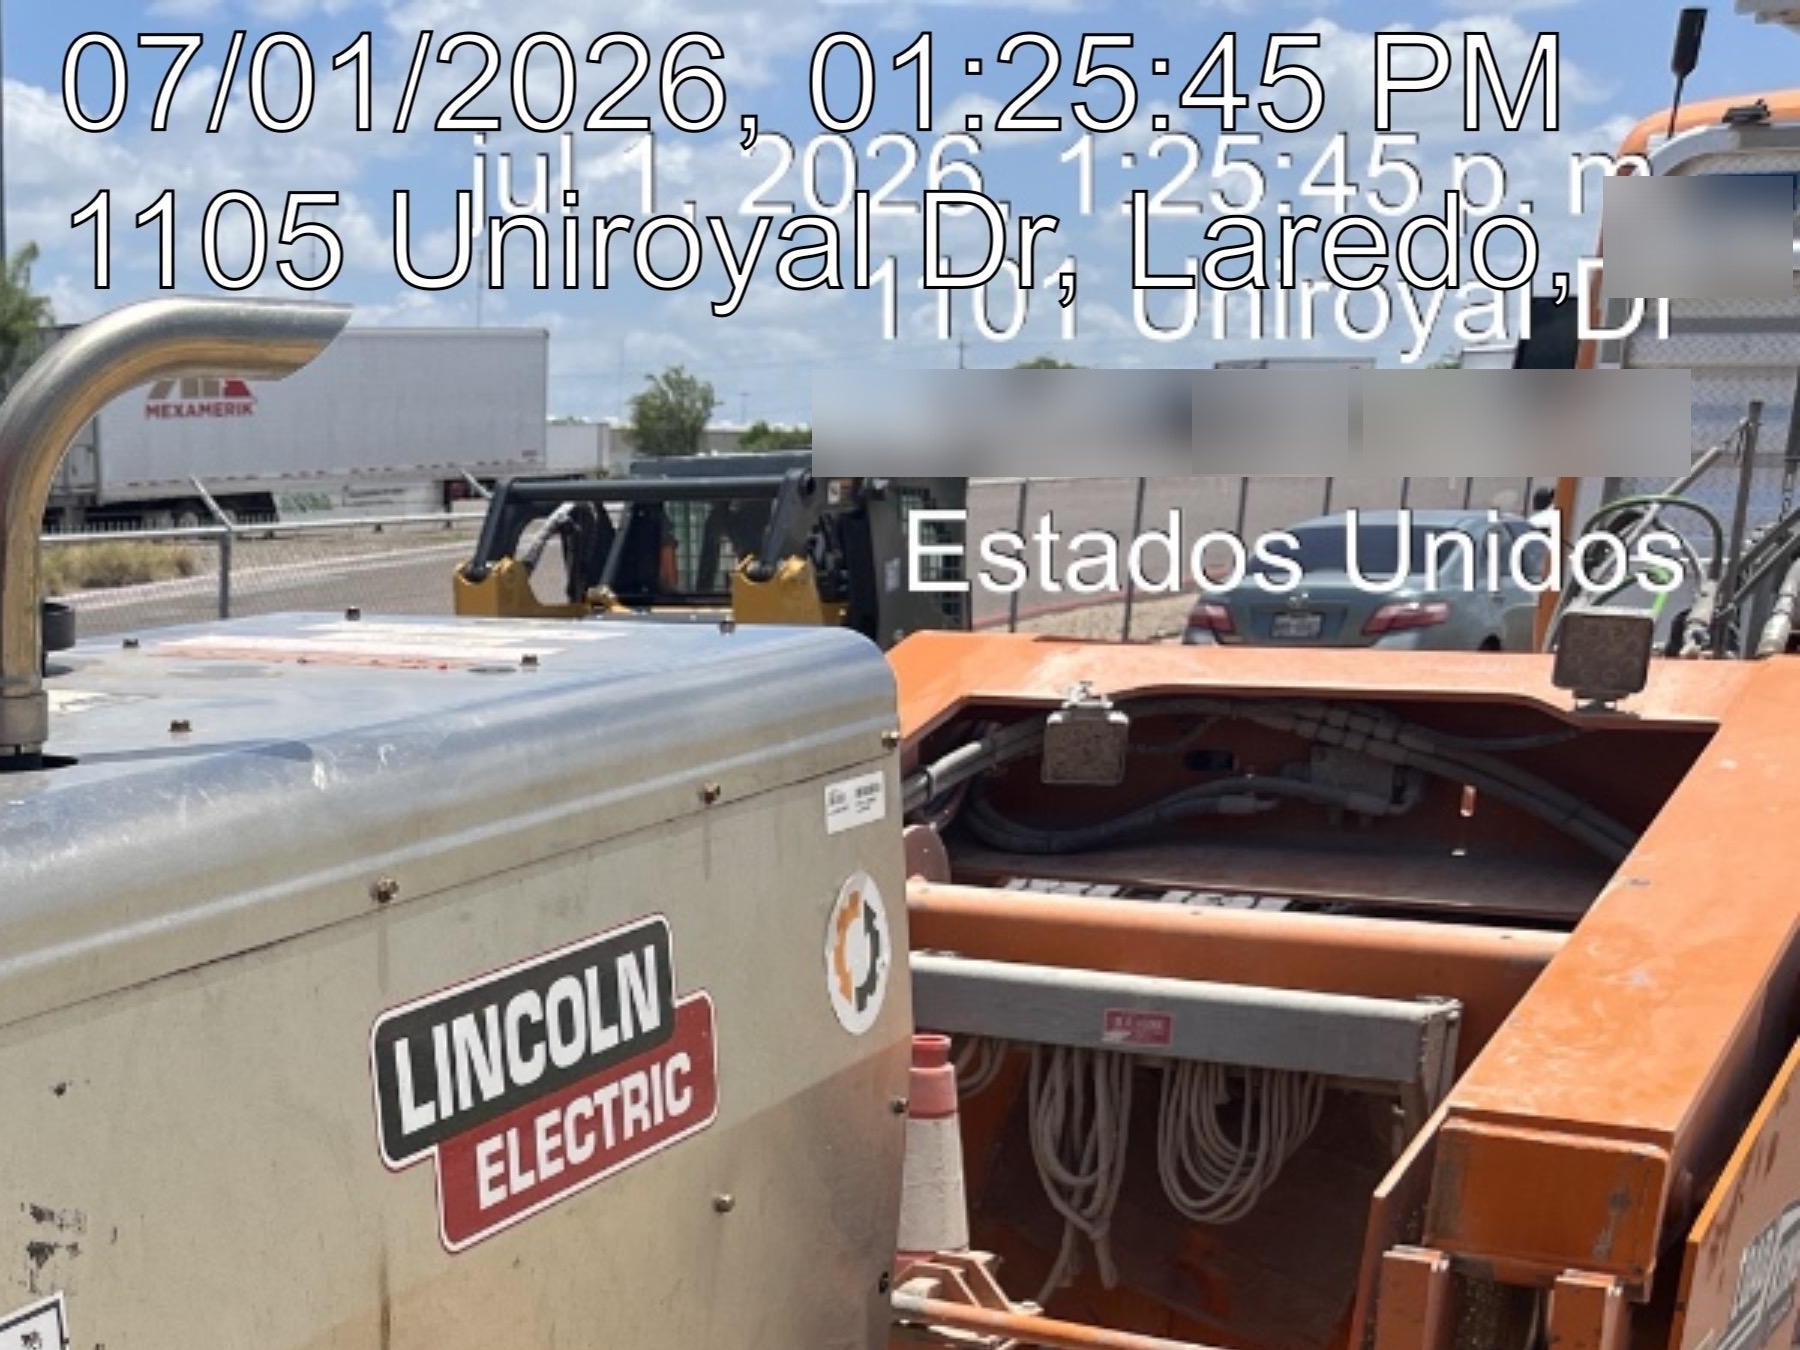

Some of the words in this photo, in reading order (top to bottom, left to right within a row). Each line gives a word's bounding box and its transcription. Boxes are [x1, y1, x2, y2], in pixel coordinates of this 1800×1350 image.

[145, 402, 254, 419] MEXAMERIK
[394, 944, 663, 1136] LINCOLN
[475, 1052, 693, 1210] ELECTRIC
